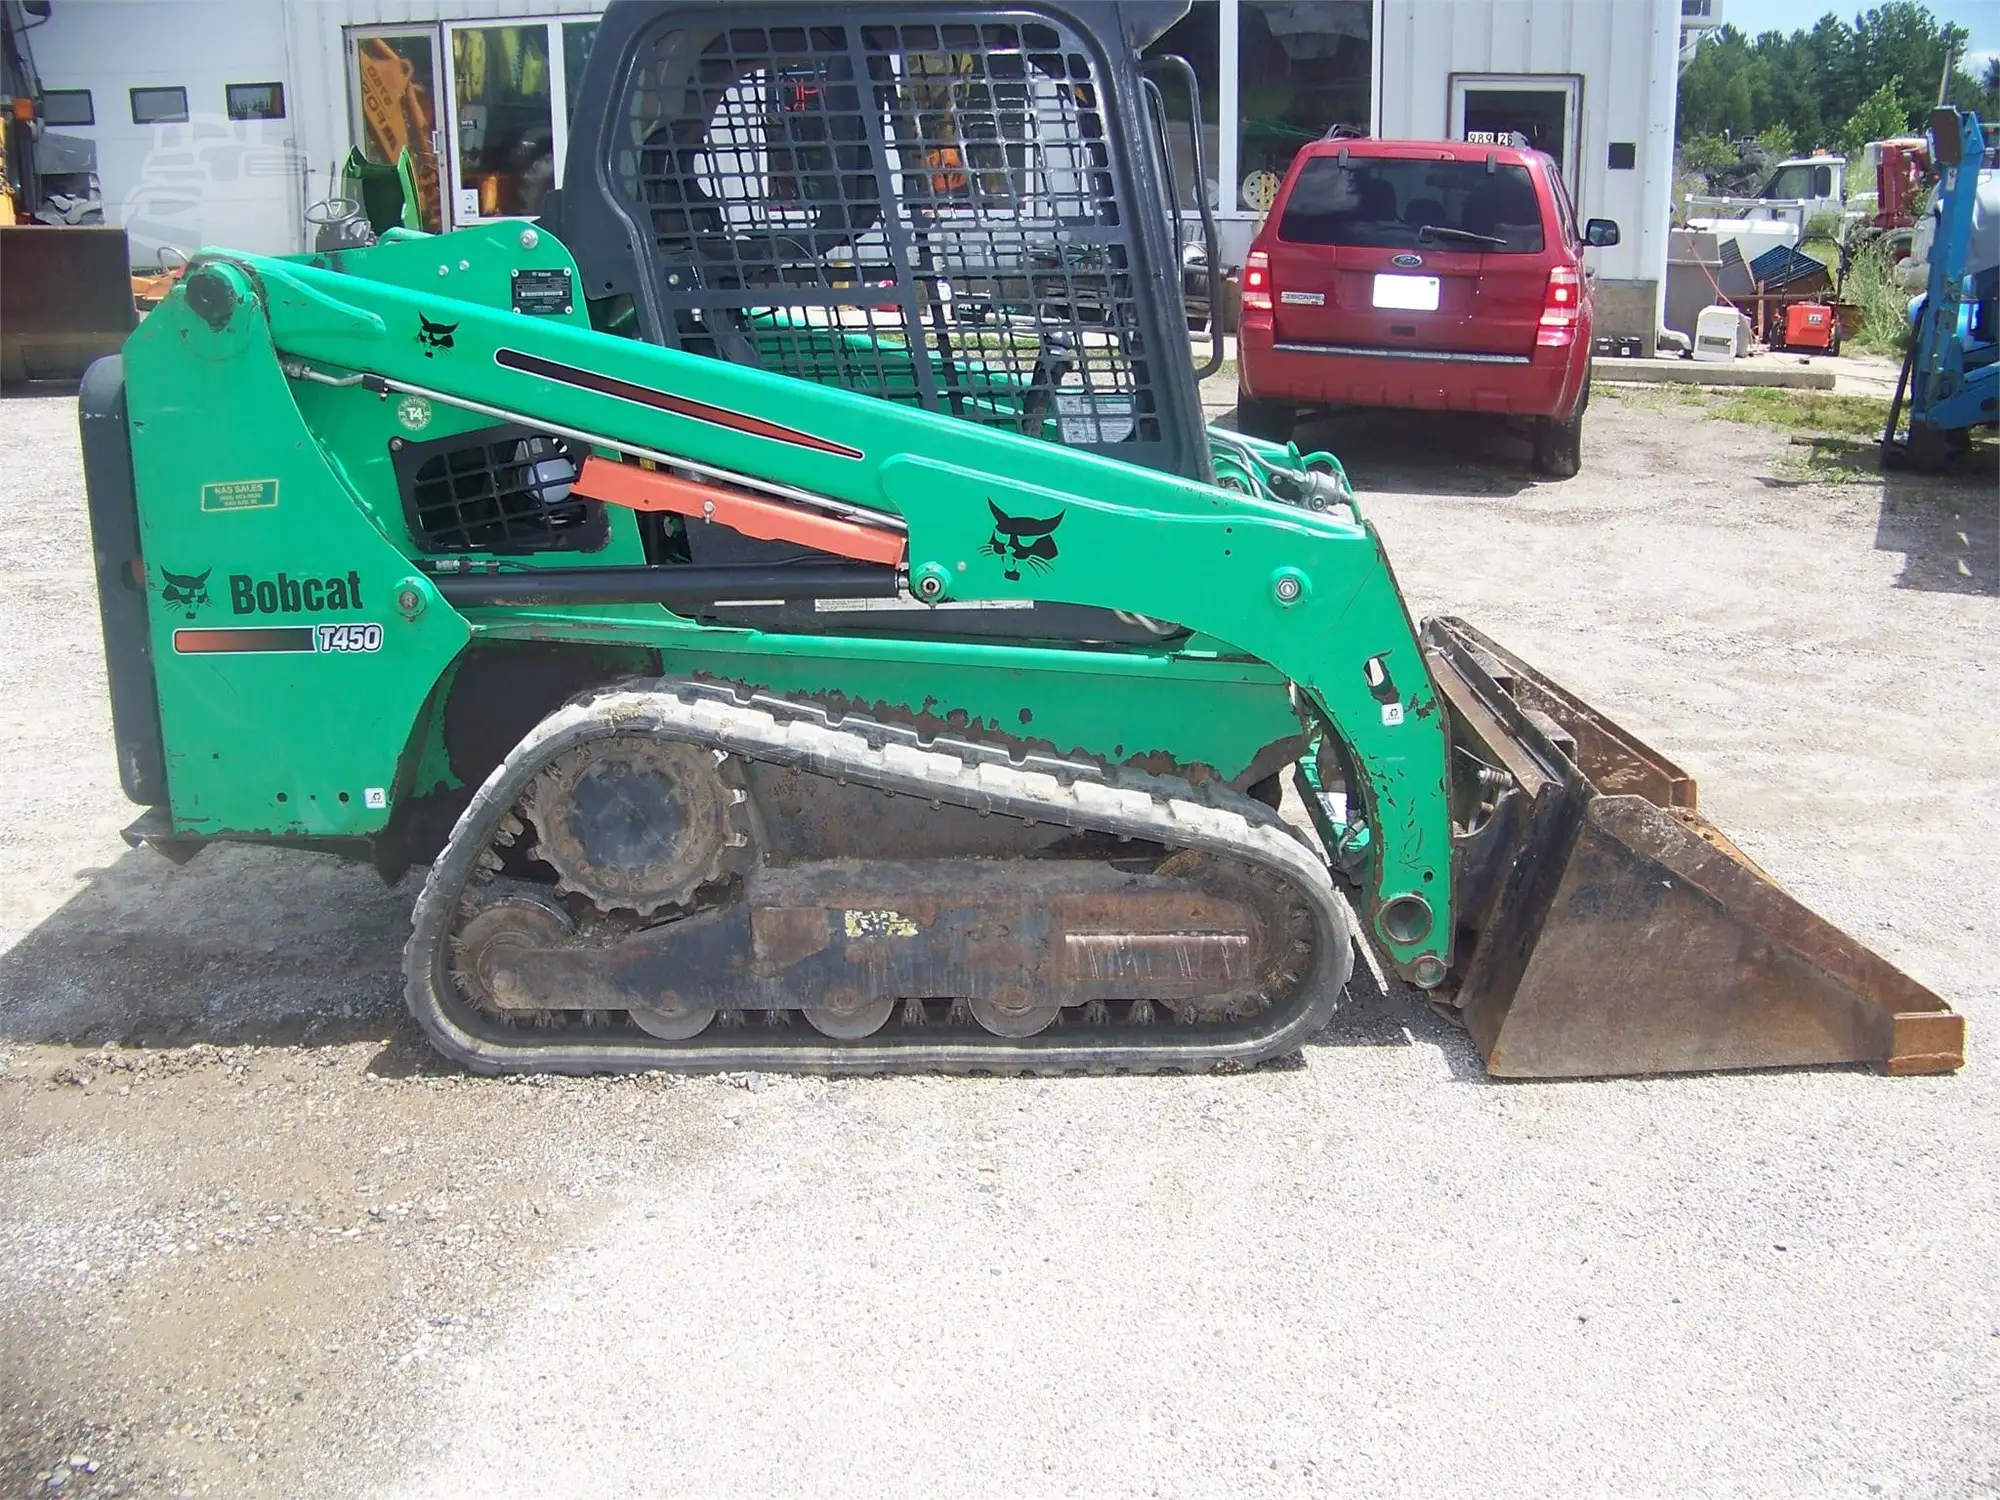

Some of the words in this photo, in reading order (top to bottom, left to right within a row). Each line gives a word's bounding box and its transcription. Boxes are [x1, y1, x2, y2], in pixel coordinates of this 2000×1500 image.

[1469, 133, 1493, 143] 989
[406, 406, 424, 421] T4
[234, 483, 264, 493] SALES
[228, 569, 364, 615] Bobcat
[318, 623, 384, 652] T450
